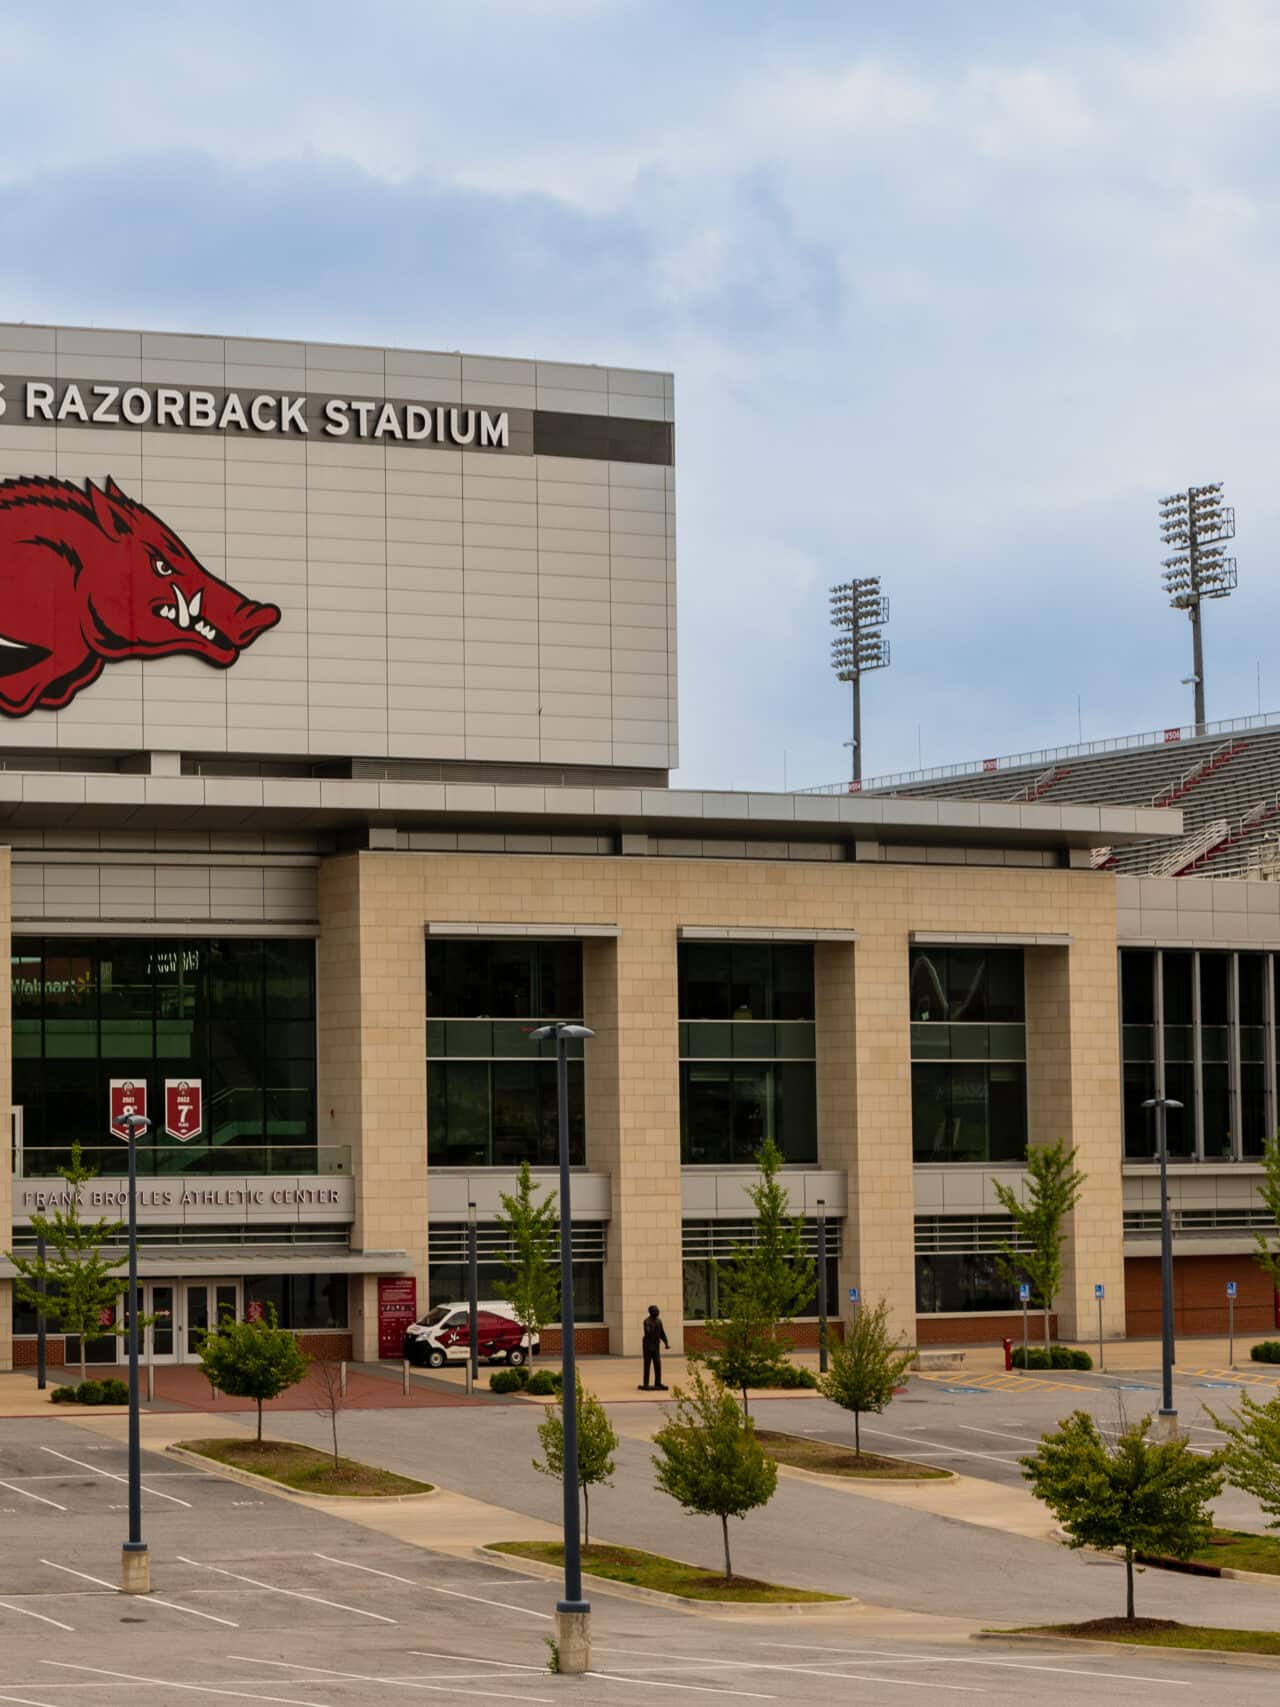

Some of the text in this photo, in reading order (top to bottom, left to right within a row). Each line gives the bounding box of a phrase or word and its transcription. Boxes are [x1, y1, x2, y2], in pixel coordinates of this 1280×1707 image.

[24, 381, 309, 434] RAZORBACK
[324, 400, 511, 448] STADIUM
[24, 1188, 340, 1206] FRANK BROLES ATHLETIC CENTER
